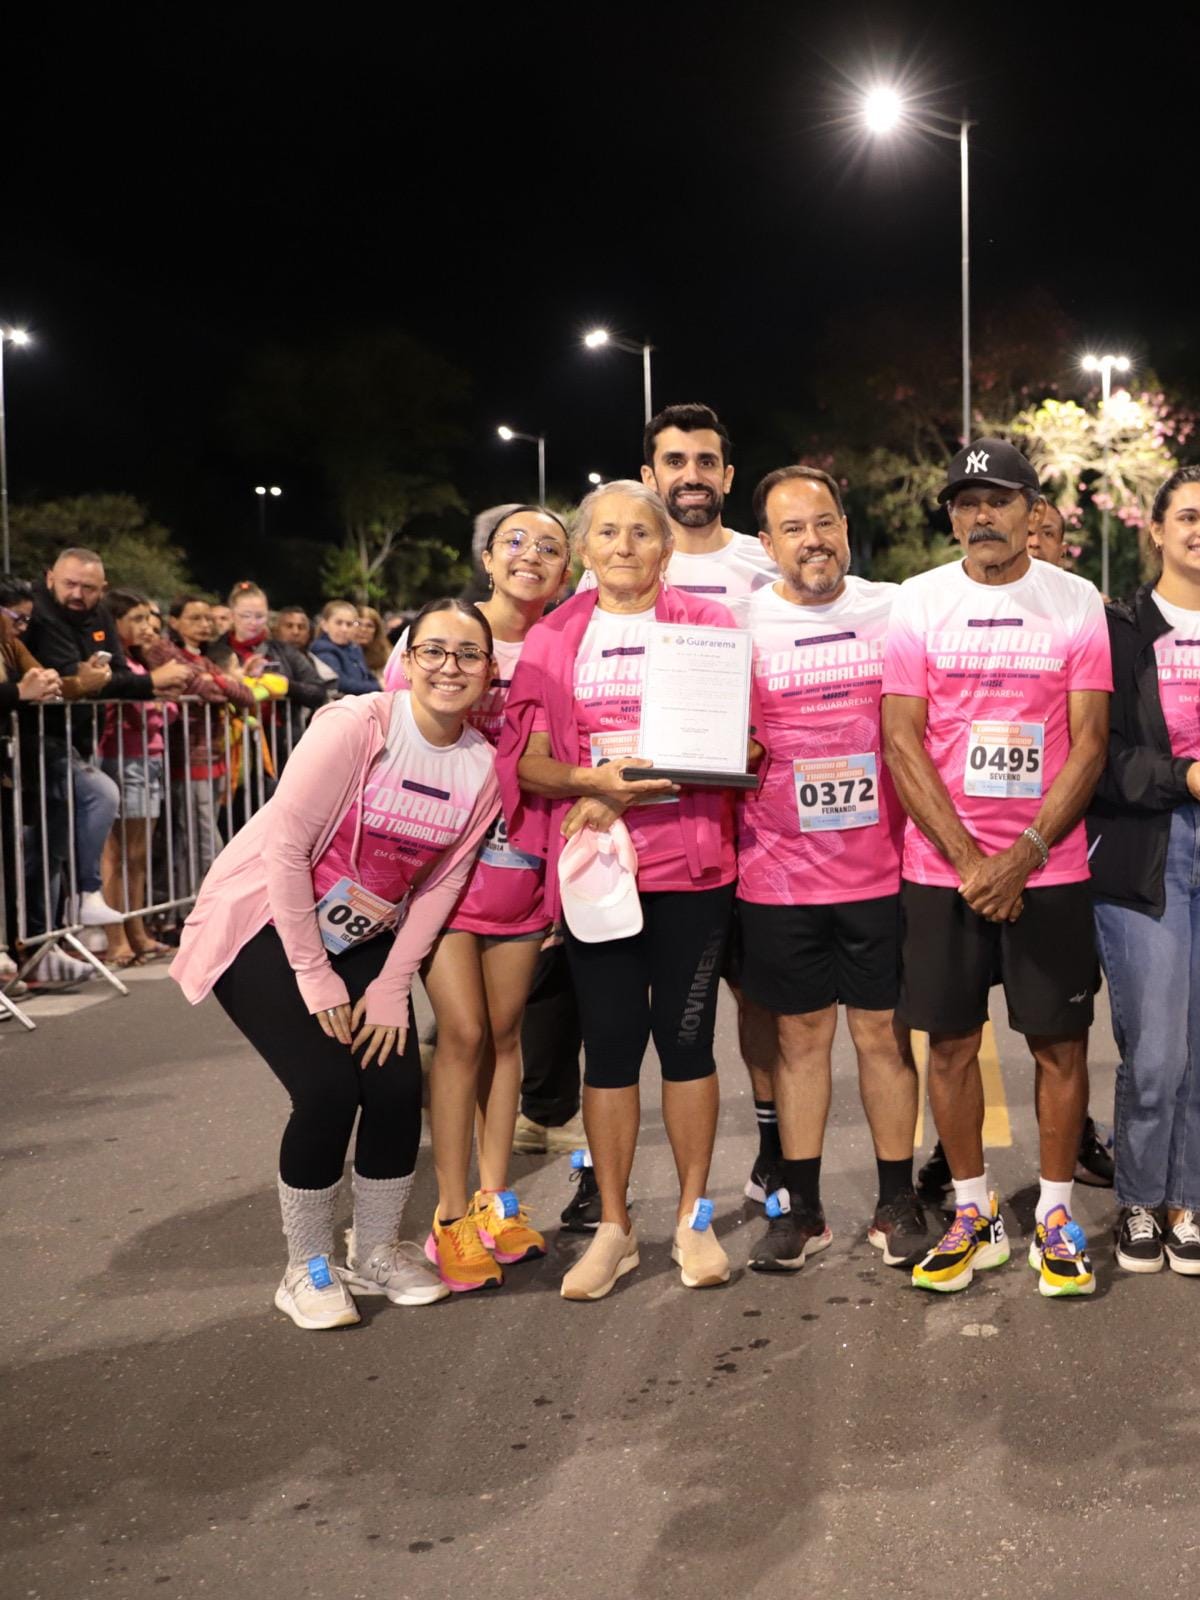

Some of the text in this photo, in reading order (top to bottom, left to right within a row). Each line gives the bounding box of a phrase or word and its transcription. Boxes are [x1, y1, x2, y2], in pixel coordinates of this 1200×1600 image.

[686, 636, 737, 650] Guararema
[926, 631, 1052, 654] CORRIDA
[936, 656, 1067, 672] DO TRABALHADOR
[768, 676, 790, 692] DO
[801, 697, 873, 714] EM GUARAREMA
[970, 746, 1040, 773] 0495
[800, 778, 875, 807] 0372
[821, 805, 857, 815] FERNANDO
